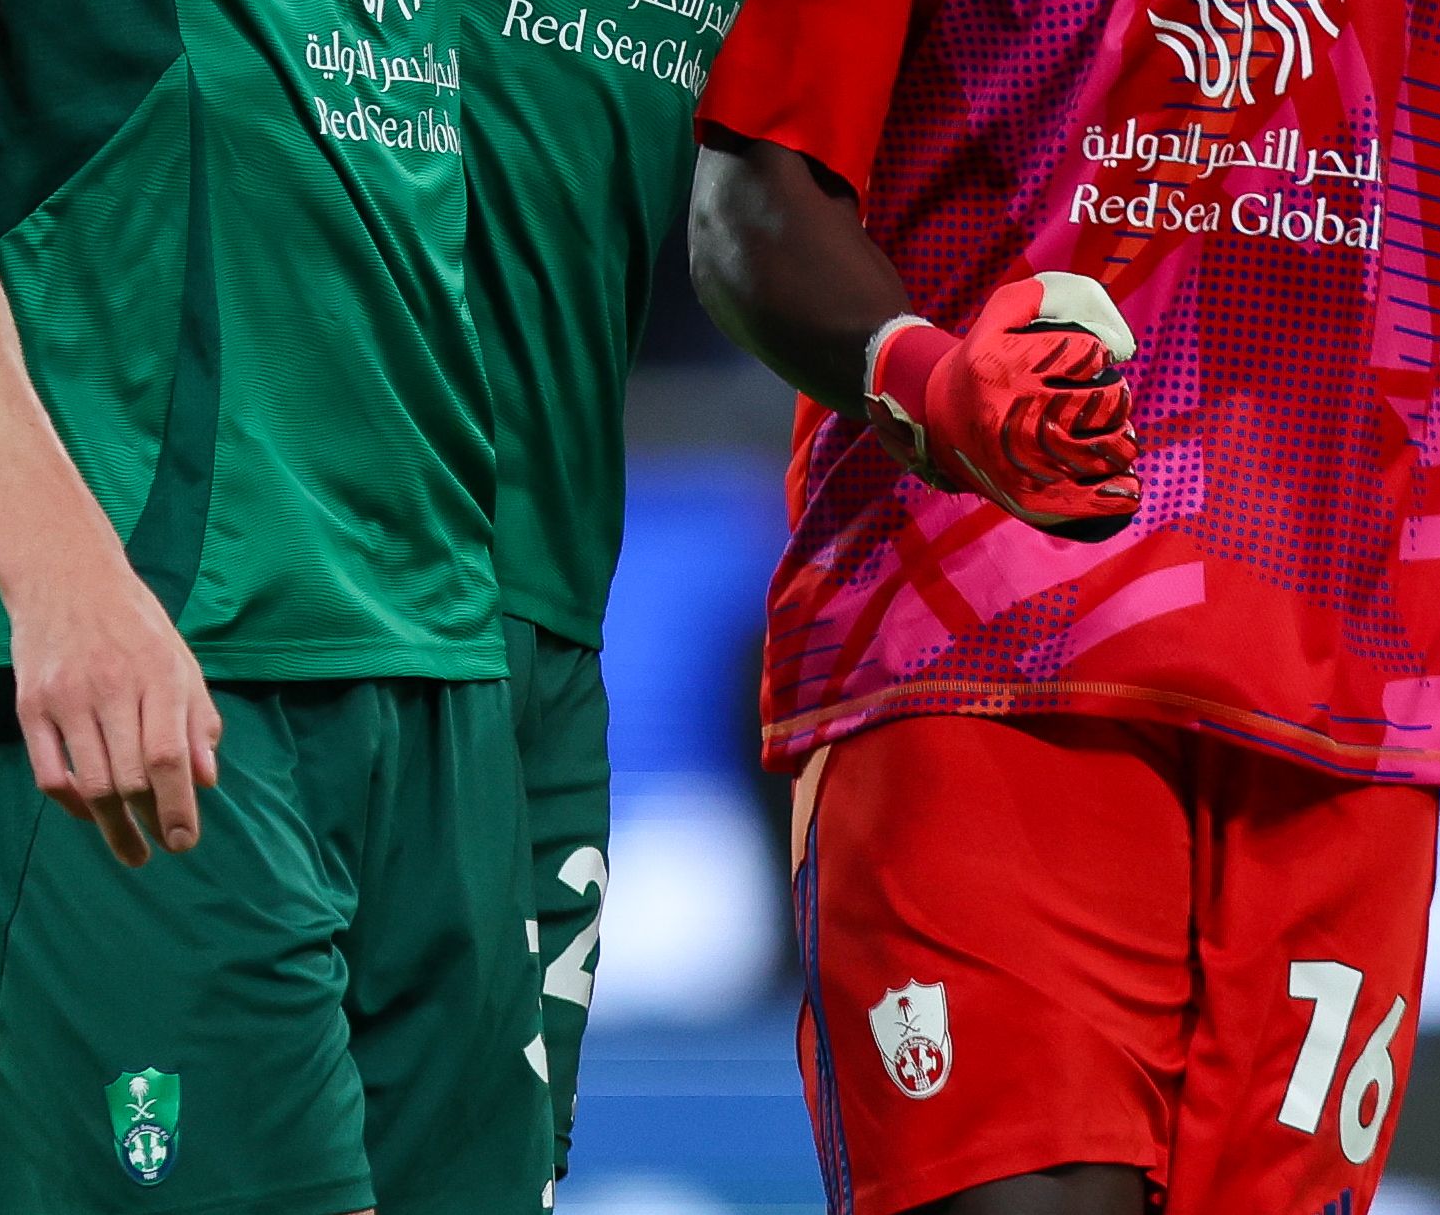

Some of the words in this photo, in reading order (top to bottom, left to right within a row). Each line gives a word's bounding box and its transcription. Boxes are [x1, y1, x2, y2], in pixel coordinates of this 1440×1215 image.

[592, 18, 648, 72] Sea
[313, 96, 368, 141] Red
[363, 104, 414, 149] Sea
[1081, 117, 1202, 173] الدولية
[1197, 126, 1300, 179] الأحمر
[1295, 138, 1383, 187] لبحر
[1068, 182, 1159, 230] Red
[1161, 189, 1222, 233] Sea
[1230, 192, 1383, 251] Global
[1276, 959, 1407, 1165] 16
